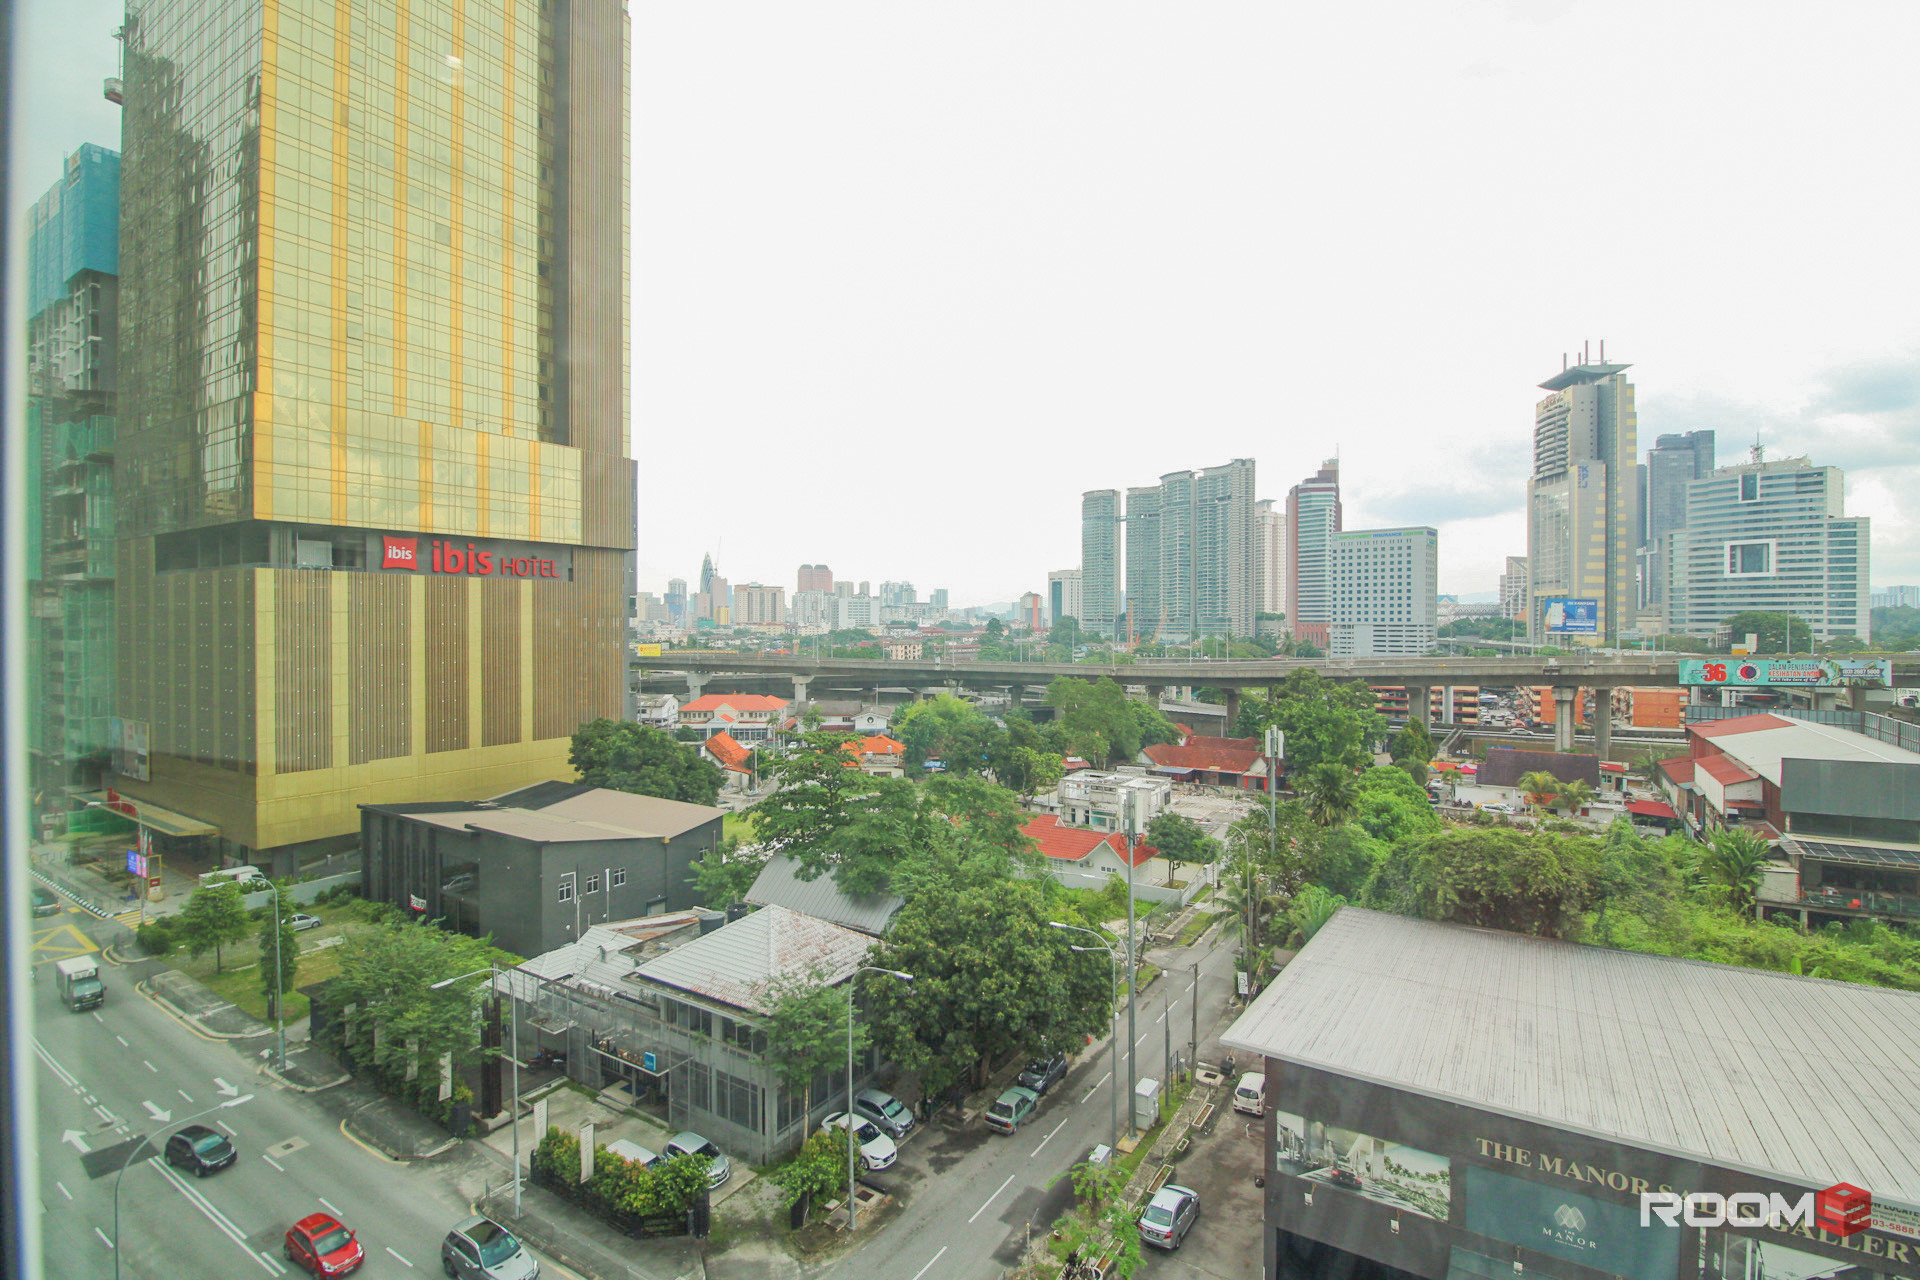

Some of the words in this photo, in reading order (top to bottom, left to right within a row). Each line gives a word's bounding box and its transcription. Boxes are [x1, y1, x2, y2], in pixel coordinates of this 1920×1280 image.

[388, 546, 412, 560] ibis
[432, 540, 494, 575] ibis
[501, 557, 560, 578] HOTEL
[1703, 663, 1727, 682] 36
[1476, 1137, 1532, 1168] THE
[1538, 1153, 1650, 1196] MANOR
[1872, 1219, 1915, 1235] 03-5888
[1542, 1227, 1597, 1249] MANOR
